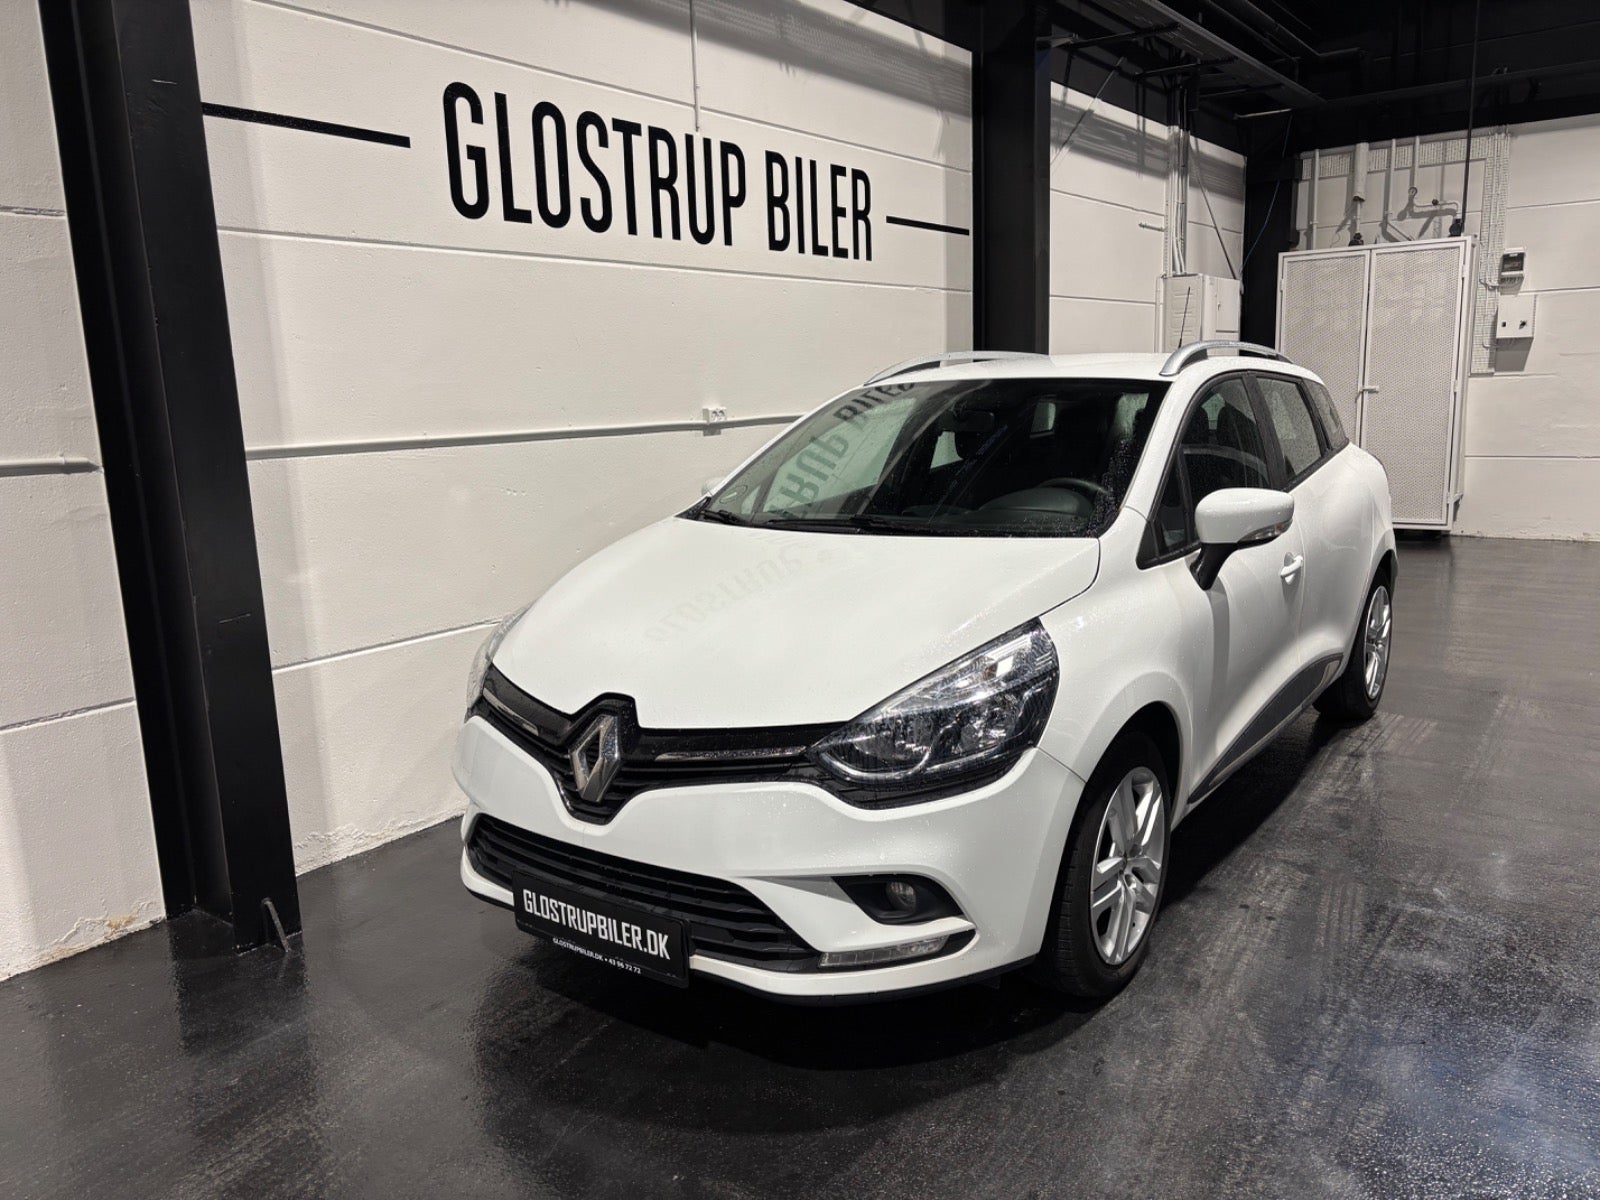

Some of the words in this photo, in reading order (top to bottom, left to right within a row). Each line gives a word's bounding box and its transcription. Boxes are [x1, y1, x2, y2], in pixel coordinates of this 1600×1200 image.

[442, 81, 746, 246] GLOSTRUP
[765, 150, 872, 262] BILER
[522, 888, 671, 960] GLOSTRUPBILER.DK
